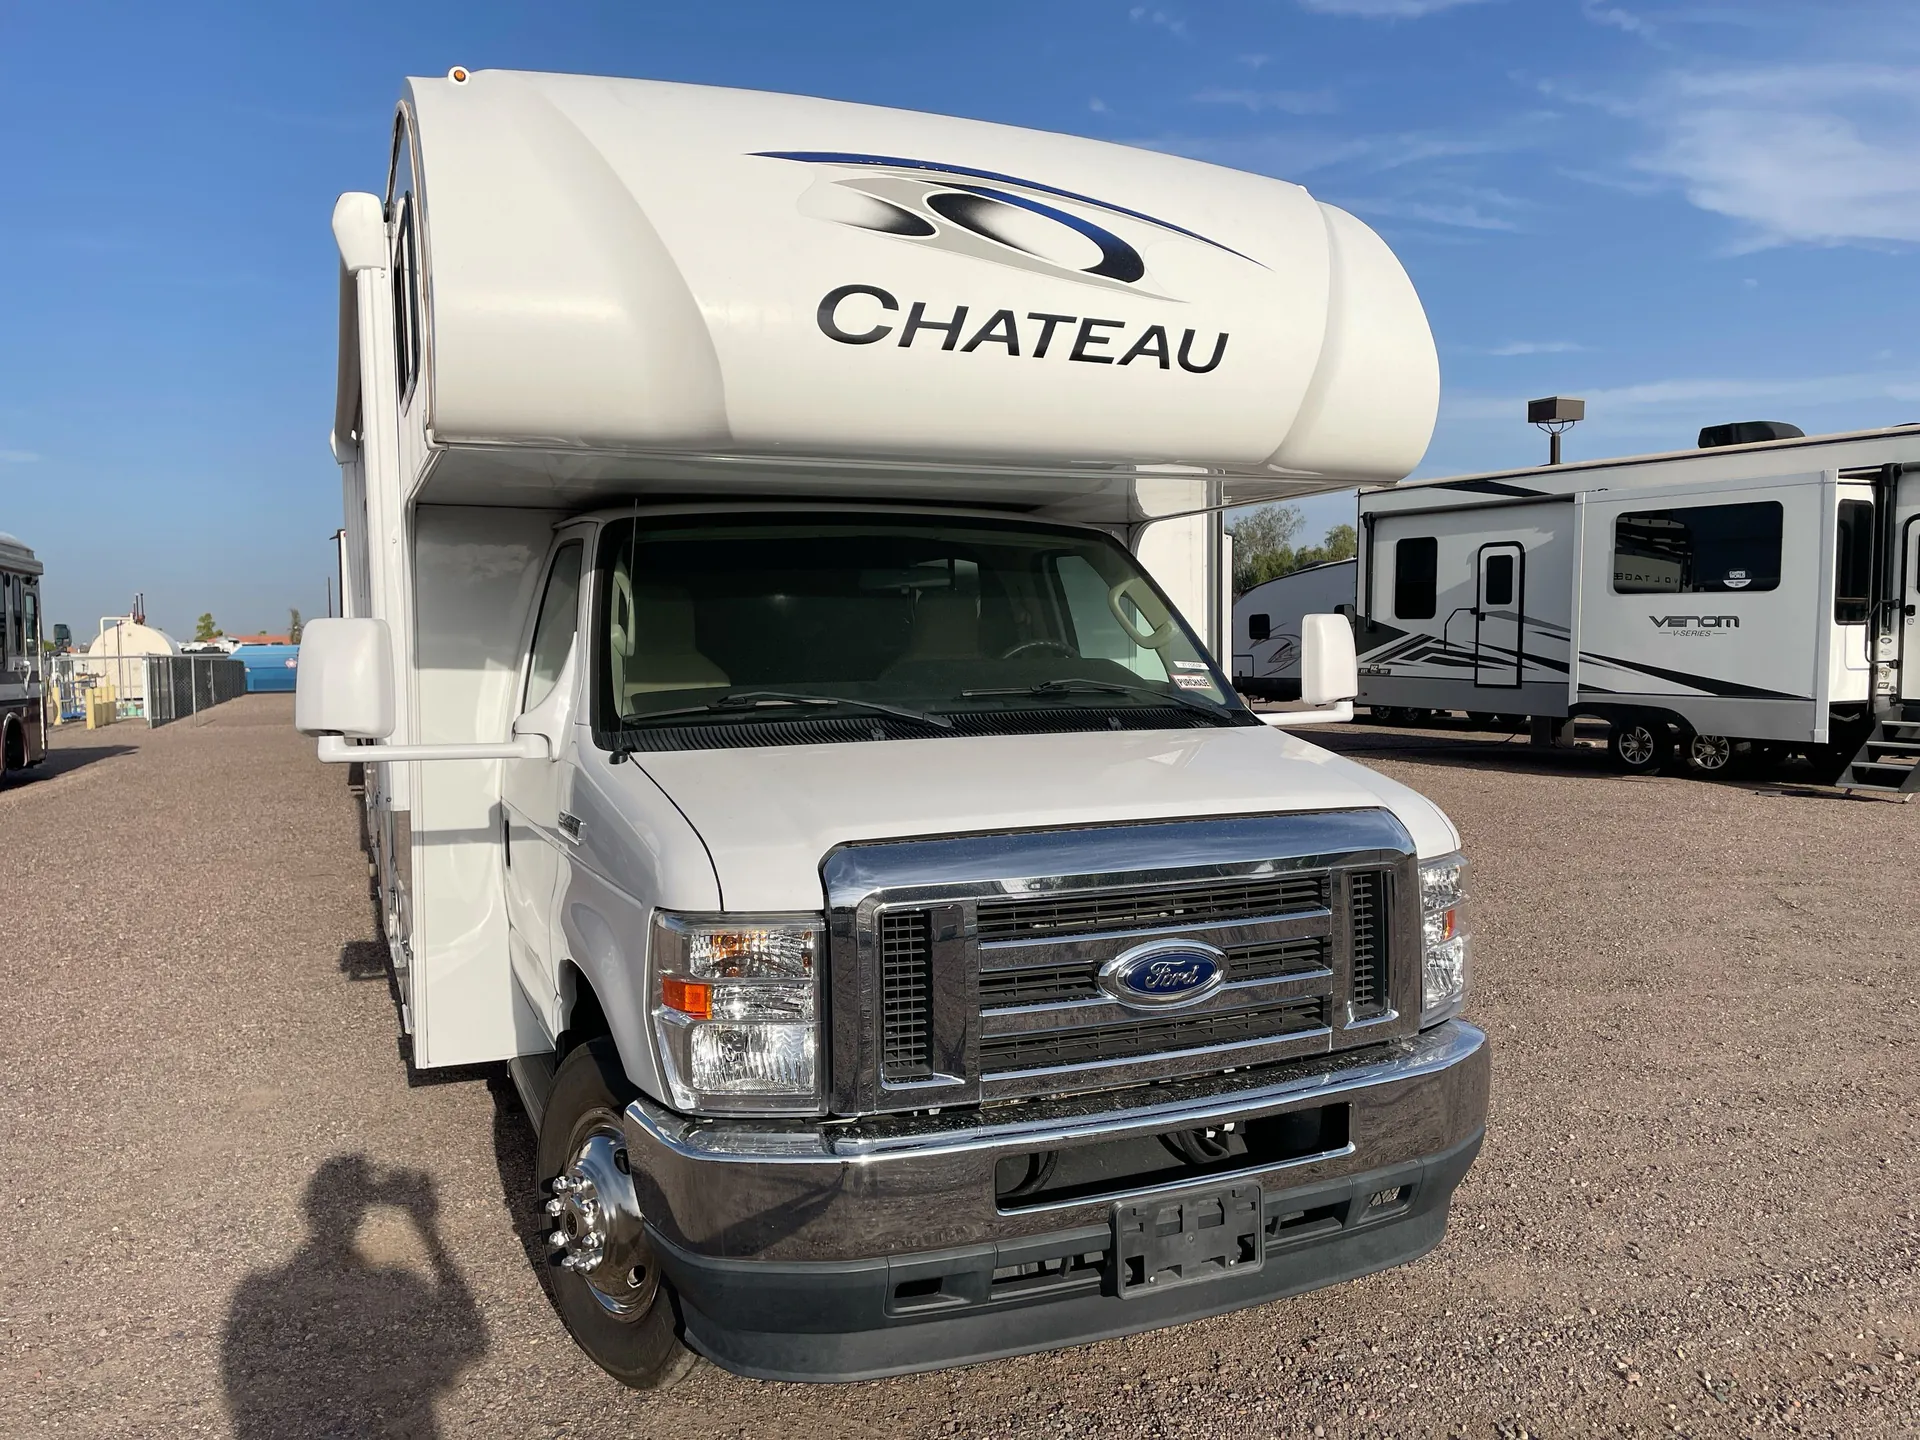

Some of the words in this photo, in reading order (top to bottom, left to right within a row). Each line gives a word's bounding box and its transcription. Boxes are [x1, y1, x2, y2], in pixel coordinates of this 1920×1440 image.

[816, 283, 1230, 374] CHATEAU
[1648, 616, 1740, 628] VENOM
[1145, 959, 1199, 988] Ford
